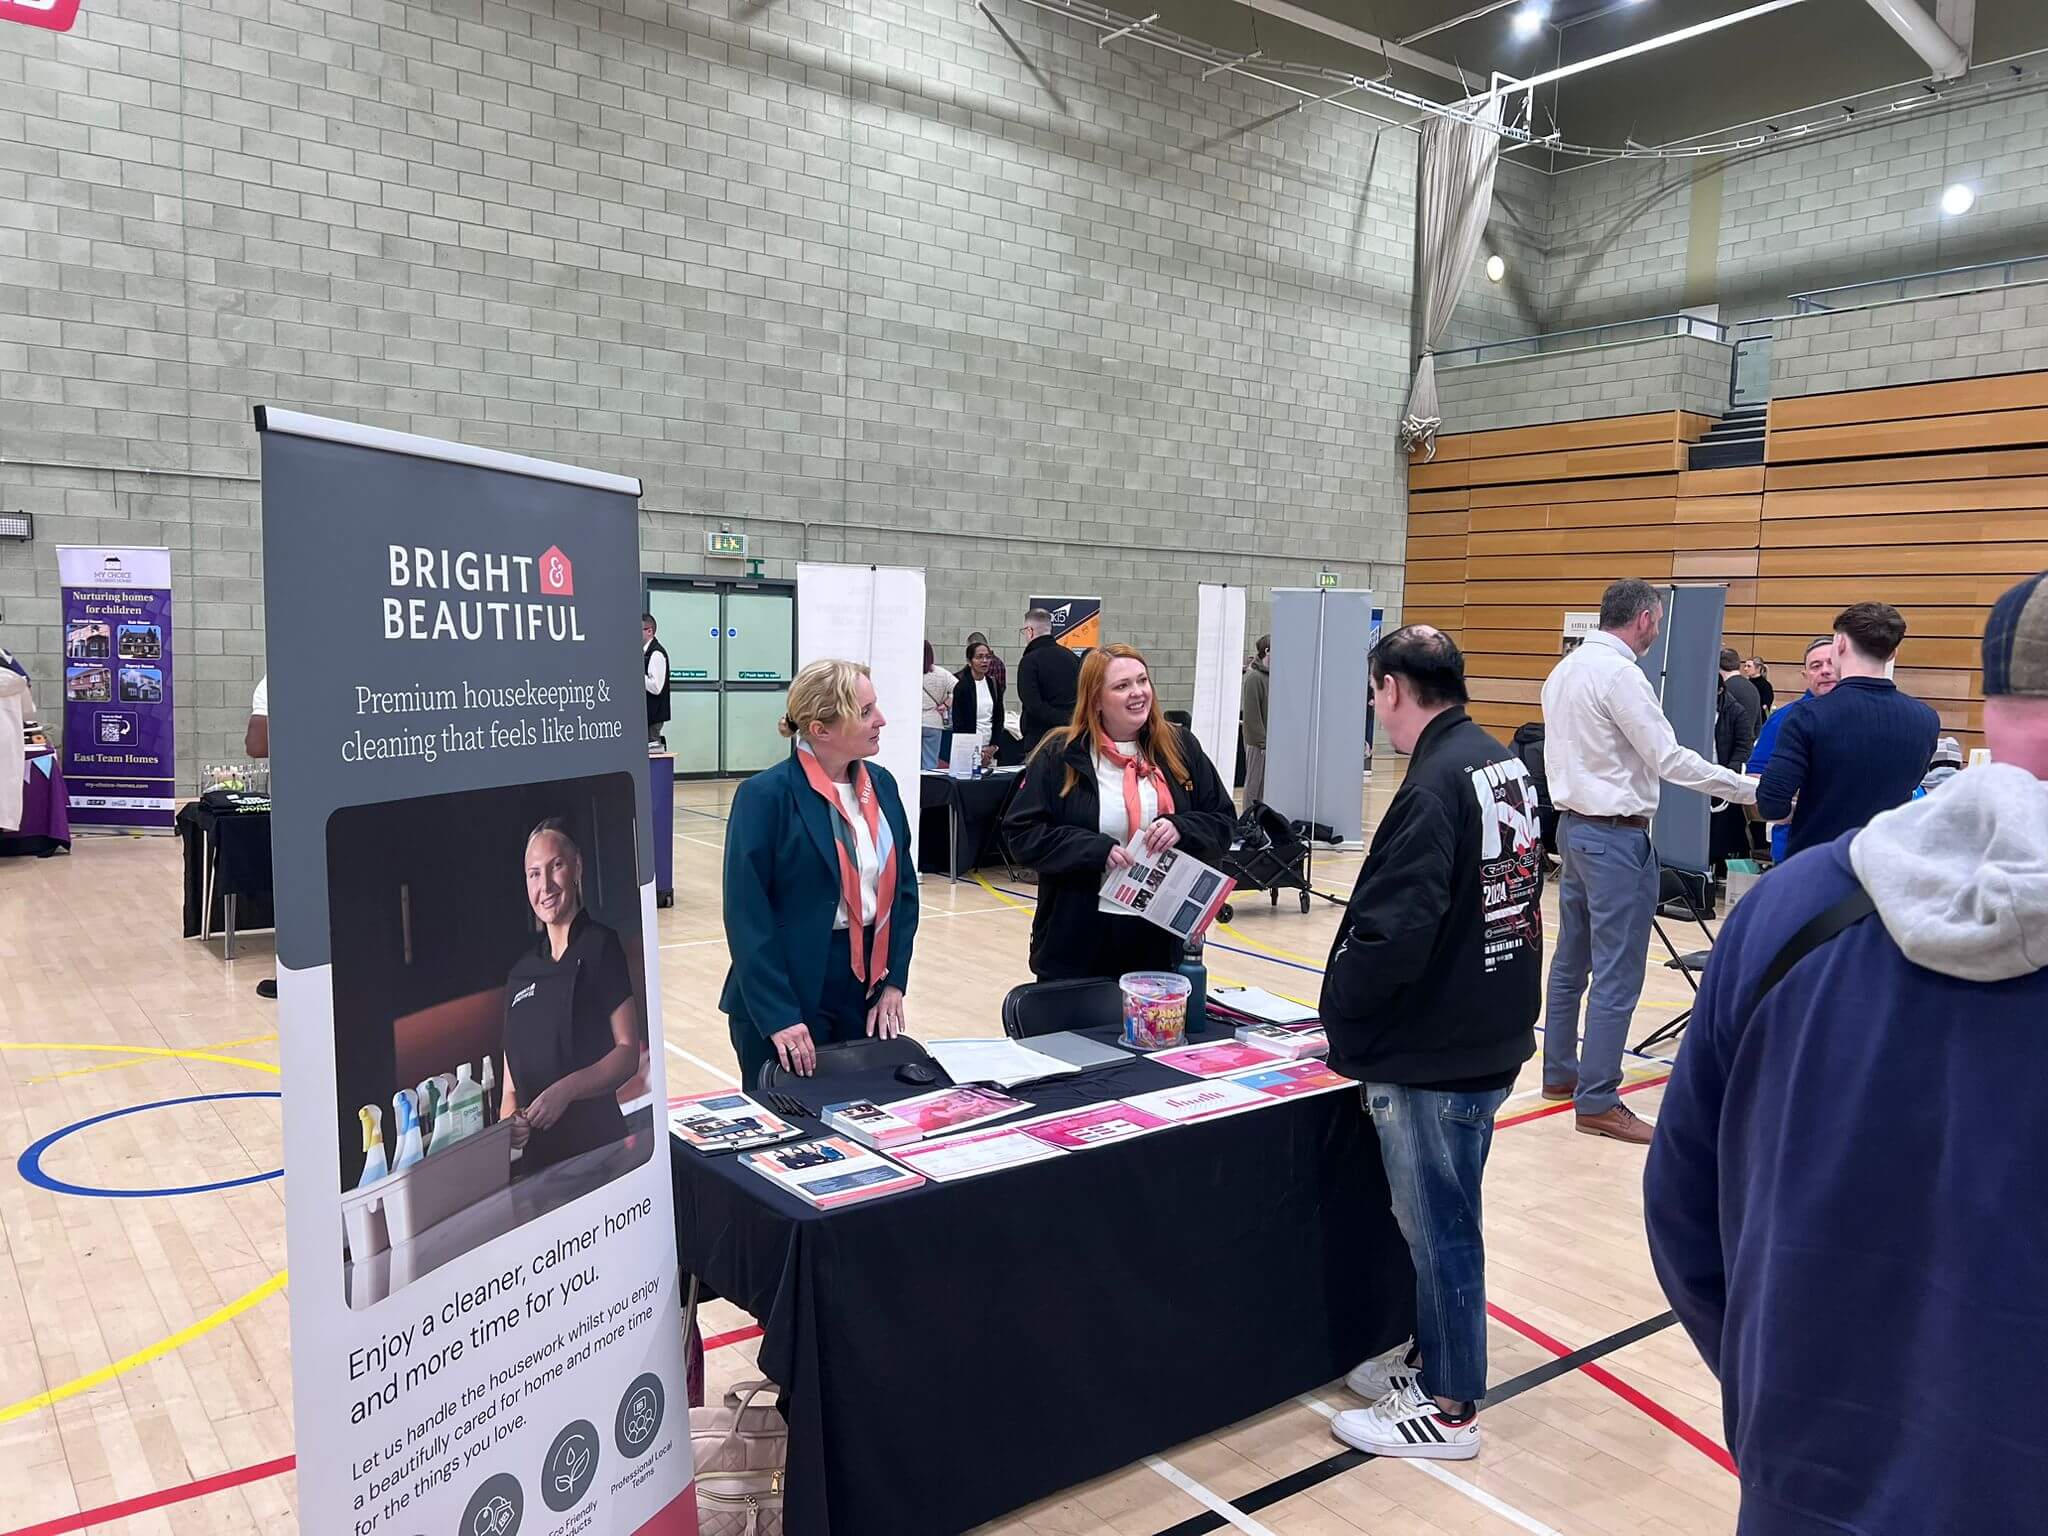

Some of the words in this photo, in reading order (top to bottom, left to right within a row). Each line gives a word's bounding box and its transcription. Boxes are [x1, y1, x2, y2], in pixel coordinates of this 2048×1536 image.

[388, 545, 533, 593] BRIGHT
[549, 556, 564, 588] &
[73, 592, 121, 603] Nurturing
[122, 592, 154, 602] homes
[85, 604, 100, 614] for
[101, 605, 142, 615] children
[383, 598, 585, 641] BEAUTIFUL
[355, 683, 458, 714] Premium
[463, 679, 595, 712] housekeeping
[598, 678, 611, 702] &
[74, 753, 95, 762] East
[96, 753, 123, 763] Team
[125, 754, 158, 764] Homes
[342, 727, 437, 762] cleaning
[441, 723, 485, 752] that
[490, 719, 537, 748] feels
[541, 717, 574, 744] like
[578, 716, 622, 741] home
[1483, 881, 1507, 907] 2024
[349, 1323, 416, 1380] Enjoy
[422, 1317, 435, 1336] a
[441, 1265, 526, 1323] cleaner,
[532, 1225, 600, 1275] calmer
[604, 1197, 652, 1239] home
[350, 1380, 399, 1424] and
[405, 1339, 464, 1390] more
[470, 1307, 520, 1345] time
[525, 1287, 555, 1320] for
[560, 1266, 600, 1308] you.
[352, 1450, 380, 1481] Let
[384, 1438, 403, 1460] us
[406, 1398, 457, 1446] handle
[461, 1381, 486, 1415] the
[489, 1333, 565, 1391] housework
[568, 1312, 605, 1343] whilst
[607, 1299, 629, 1327] you
[631, 1276, 661, 1305] enjoy
[353, 1494, 364, 1510] a
[369, 1434, 450, 1500] beautifully
[454, 1404, 498, 1440] cared
[500, 1388, 522, 1414] for
[524, 1362, 563, 1398] home
[566, 1343, 591, 1370] and
[594, 1326, 626, 1355] more
[627, 1307, 653, 1331] time
[354, 1513, 379, 1536] for
[384, 1493, 410, 1520] the
[414, 1457, 460, 1498] things
[464, 1436, 491, 1468] you
[494, 1414, 527, 1443] love.
[610, 1456, 654, 1495] Professional
[654, 1440, 673, 1461] Local
[631, 1467, 655, 1489] Teams
[565, 1500, 598, 1530] Friendly
